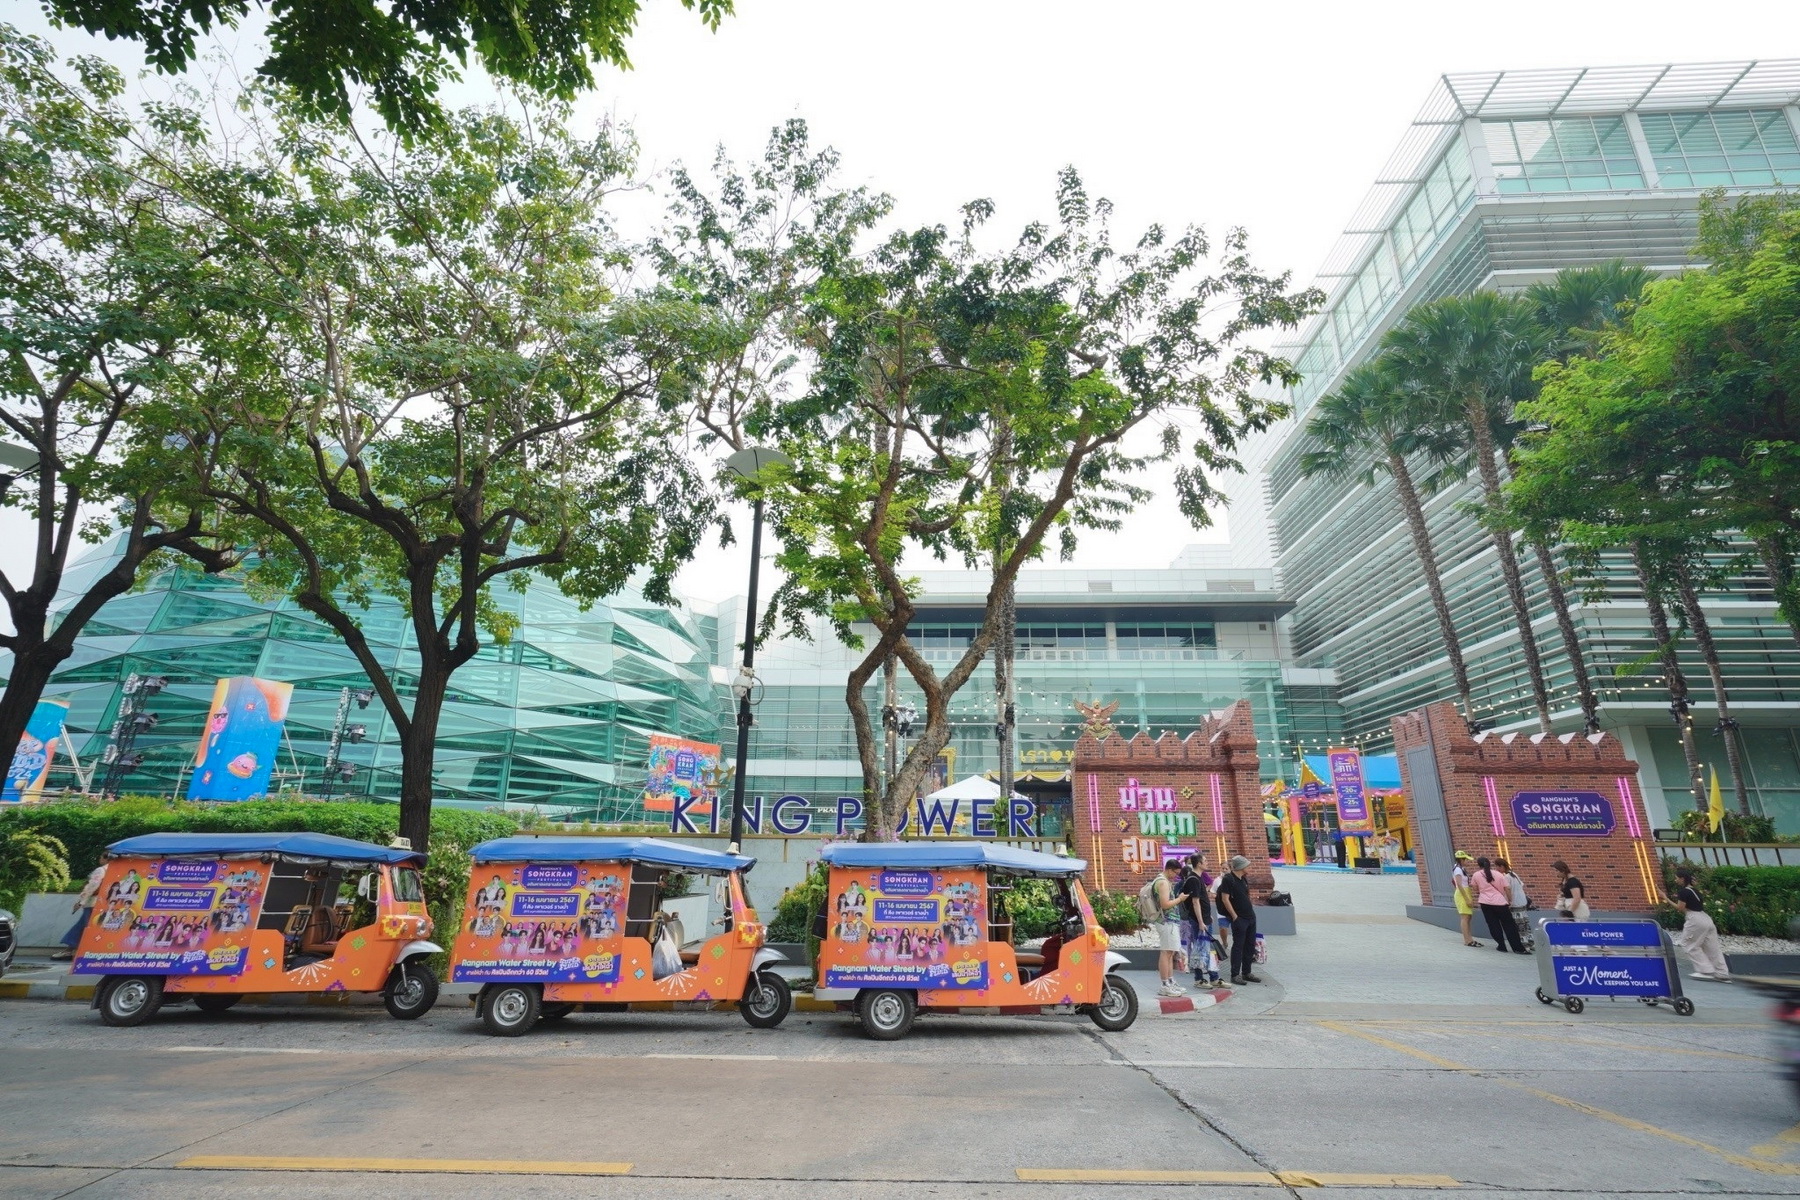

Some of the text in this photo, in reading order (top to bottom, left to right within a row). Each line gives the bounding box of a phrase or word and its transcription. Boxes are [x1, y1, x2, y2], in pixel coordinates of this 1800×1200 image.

[1118, 777, 1177, 812] ม่วน
[1522, 803, 1601, 814] SONGKRAN
[672, 795, 1037, 837] KING PWER
[1121, 836, 1159, 874] สุข
[84, 951, 180, 961] Rangnam Water Street by
[461, 959, 557, 969] Rangnam Water Street by
[832, 964, 926, 974] Rangnam Water Street by
